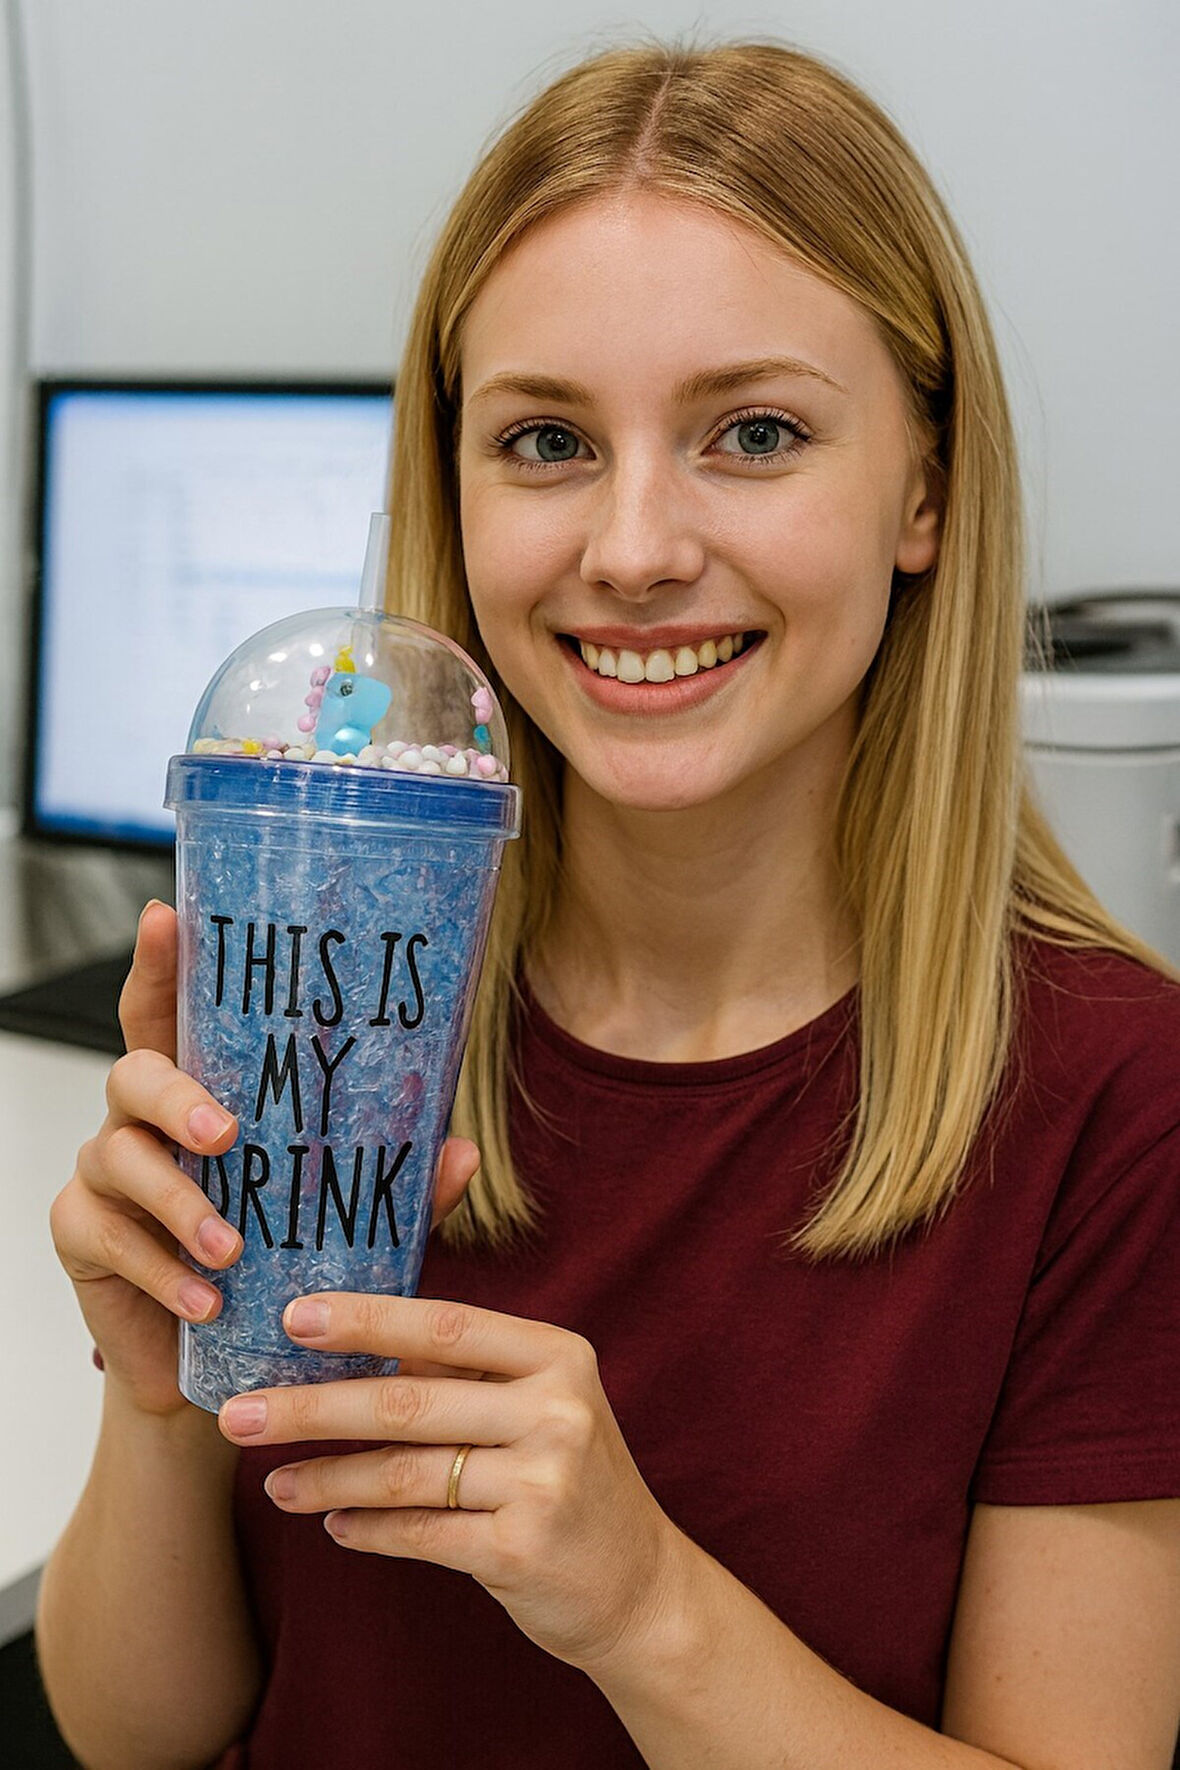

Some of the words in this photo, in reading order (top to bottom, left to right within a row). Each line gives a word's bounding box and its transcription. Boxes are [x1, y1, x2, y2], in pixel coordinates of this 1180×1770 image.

[210, 915, 346, 1027] THIS
[369, 932, 428, 1029] IS
[254, 1033, 357, 1137] MY
[201, 1141, 412, 1251] DRINK
